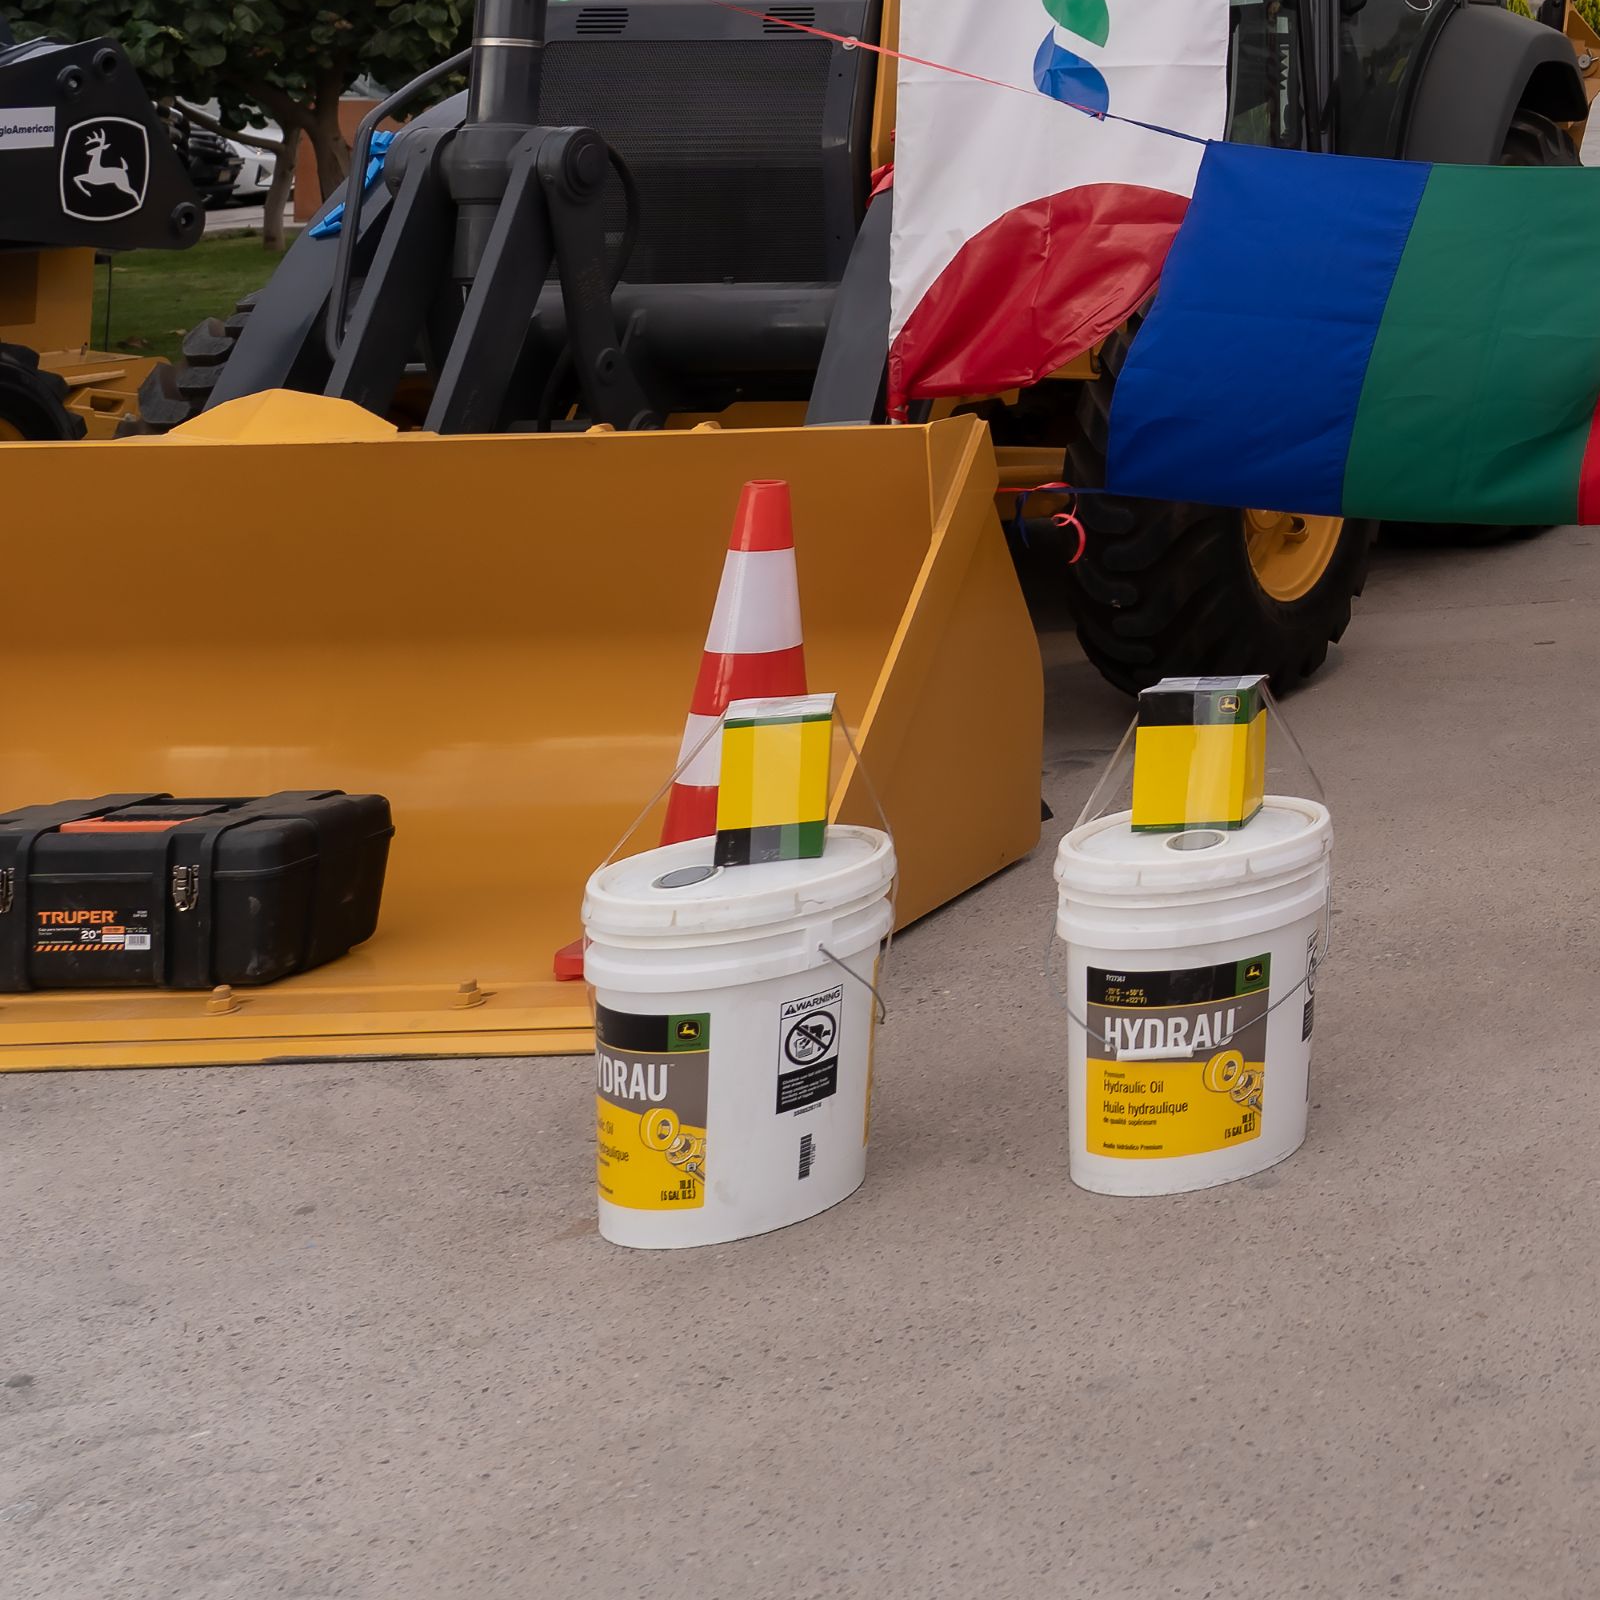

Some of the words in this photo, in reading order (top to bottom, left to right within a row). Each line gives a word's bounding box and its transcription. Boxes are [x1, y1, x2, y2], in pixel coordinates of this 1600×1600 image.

[38, 910, 115, 924] TRUPER
[795, 989, 841, 1011] WARNING
[1104, 1008, 1236, 1052] HYDRAU
[1103, 1079, 1147, 1094] Hydraulic
[1150, 1080, 1164, 1094] Oil
[1103, 1100, 1125, 1114] Huile
[1128, 1101, 1188, 1117] hydraulique
